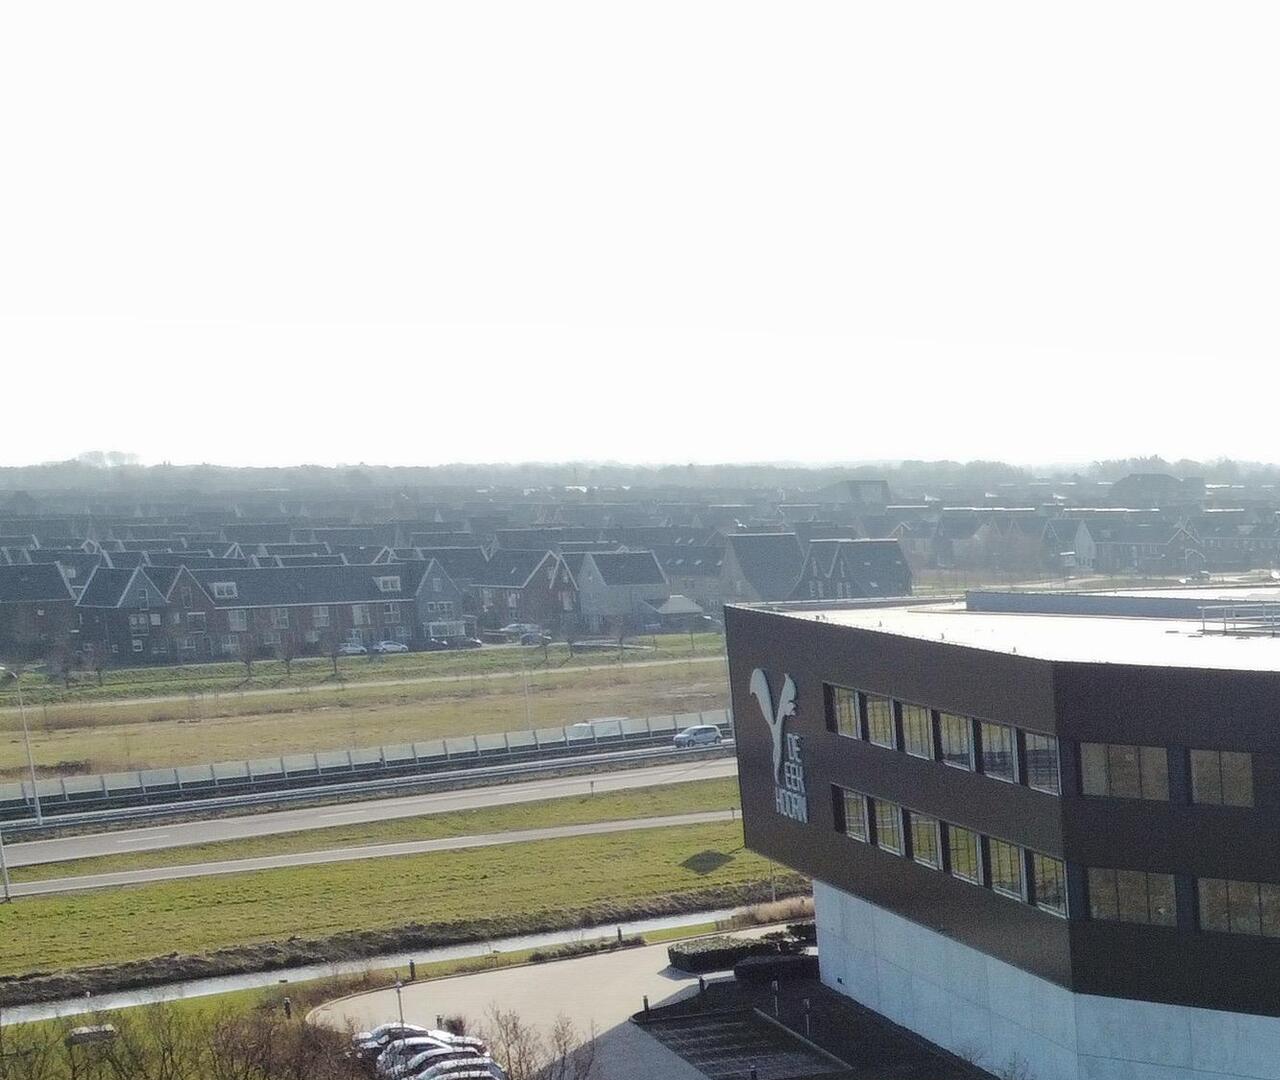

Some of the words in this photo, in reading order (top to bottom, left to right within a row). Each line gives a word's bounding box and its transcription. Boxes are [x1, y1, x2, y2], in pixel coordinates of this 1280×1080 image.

[787, 733, 801, 762] DE
[784, 761, 806, 797] EEK
[775, 786, 808, 824] HOORN
